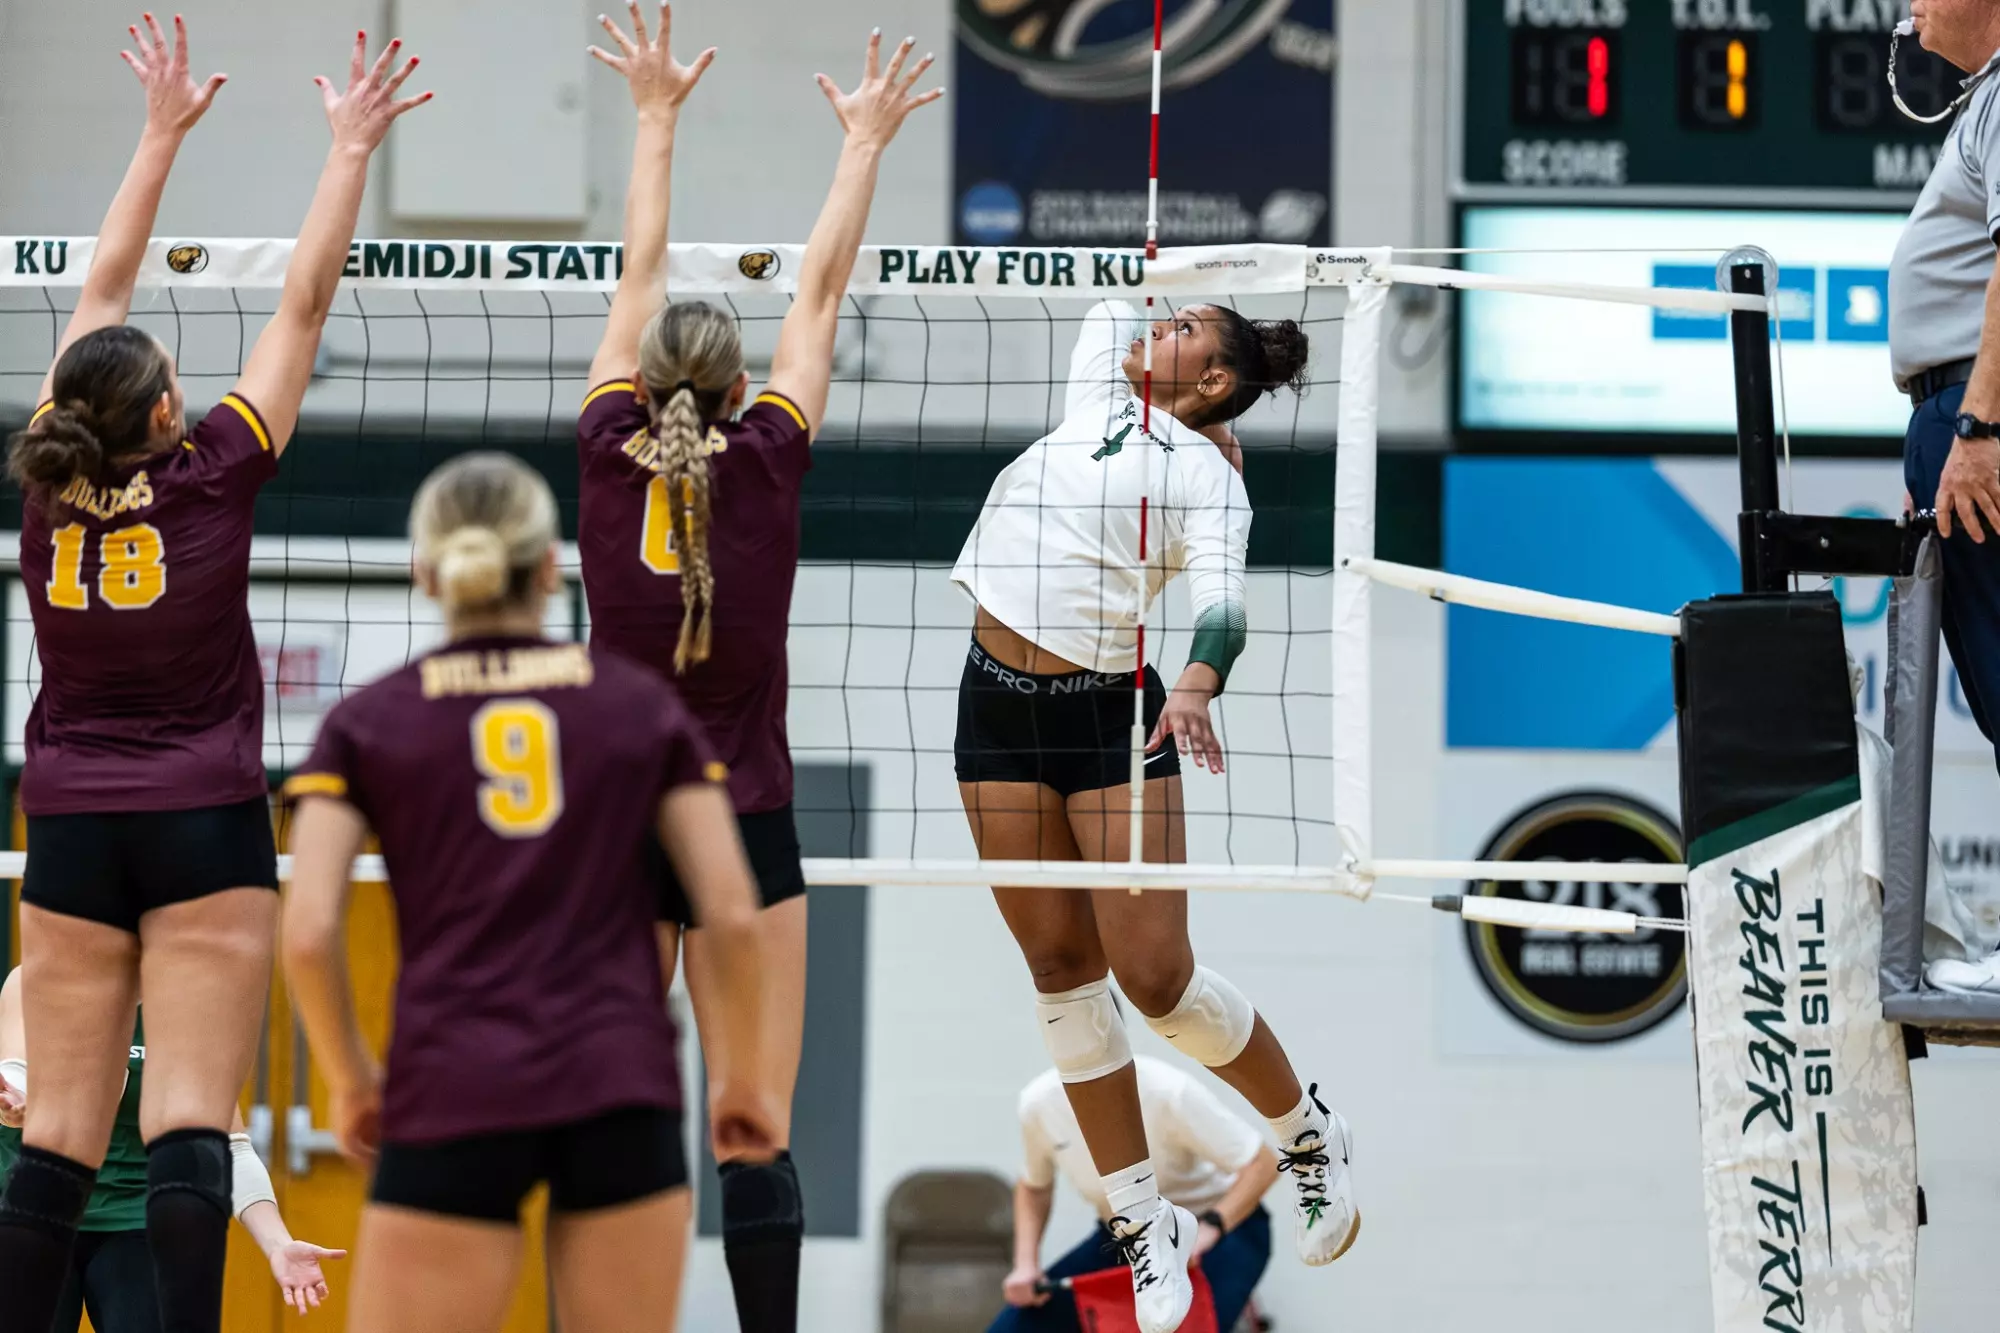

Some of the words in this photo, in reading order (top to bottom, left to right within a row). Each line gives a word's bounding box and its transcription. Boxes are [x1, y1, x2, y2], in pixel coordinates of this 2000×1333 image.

[1805, 0, 1909, 31] PLAY
[1502, 140, 1628, 185] SCORE
[14, 240, 69, 275] KU
[341, 242, 492, 279] EMIDJI
[879, 248, 982, 284] PLAY
[996, 250, 1076, 287] FOR
[1092, 252, 1146, 287] KU
[1327, 254, 1368, 265] Senoh
[46, 521, 167, 612] 18
[982, 658, 1038, 694] PRO
[1049, 672, 1122, 695] NIKE
[469, 697, 565, 840] 9
[1797, 898, 1830, 1026] THIS
[1730, 867, 1798, 1136] BEAVER
[1804, 1047, 1833, 1097] IS
